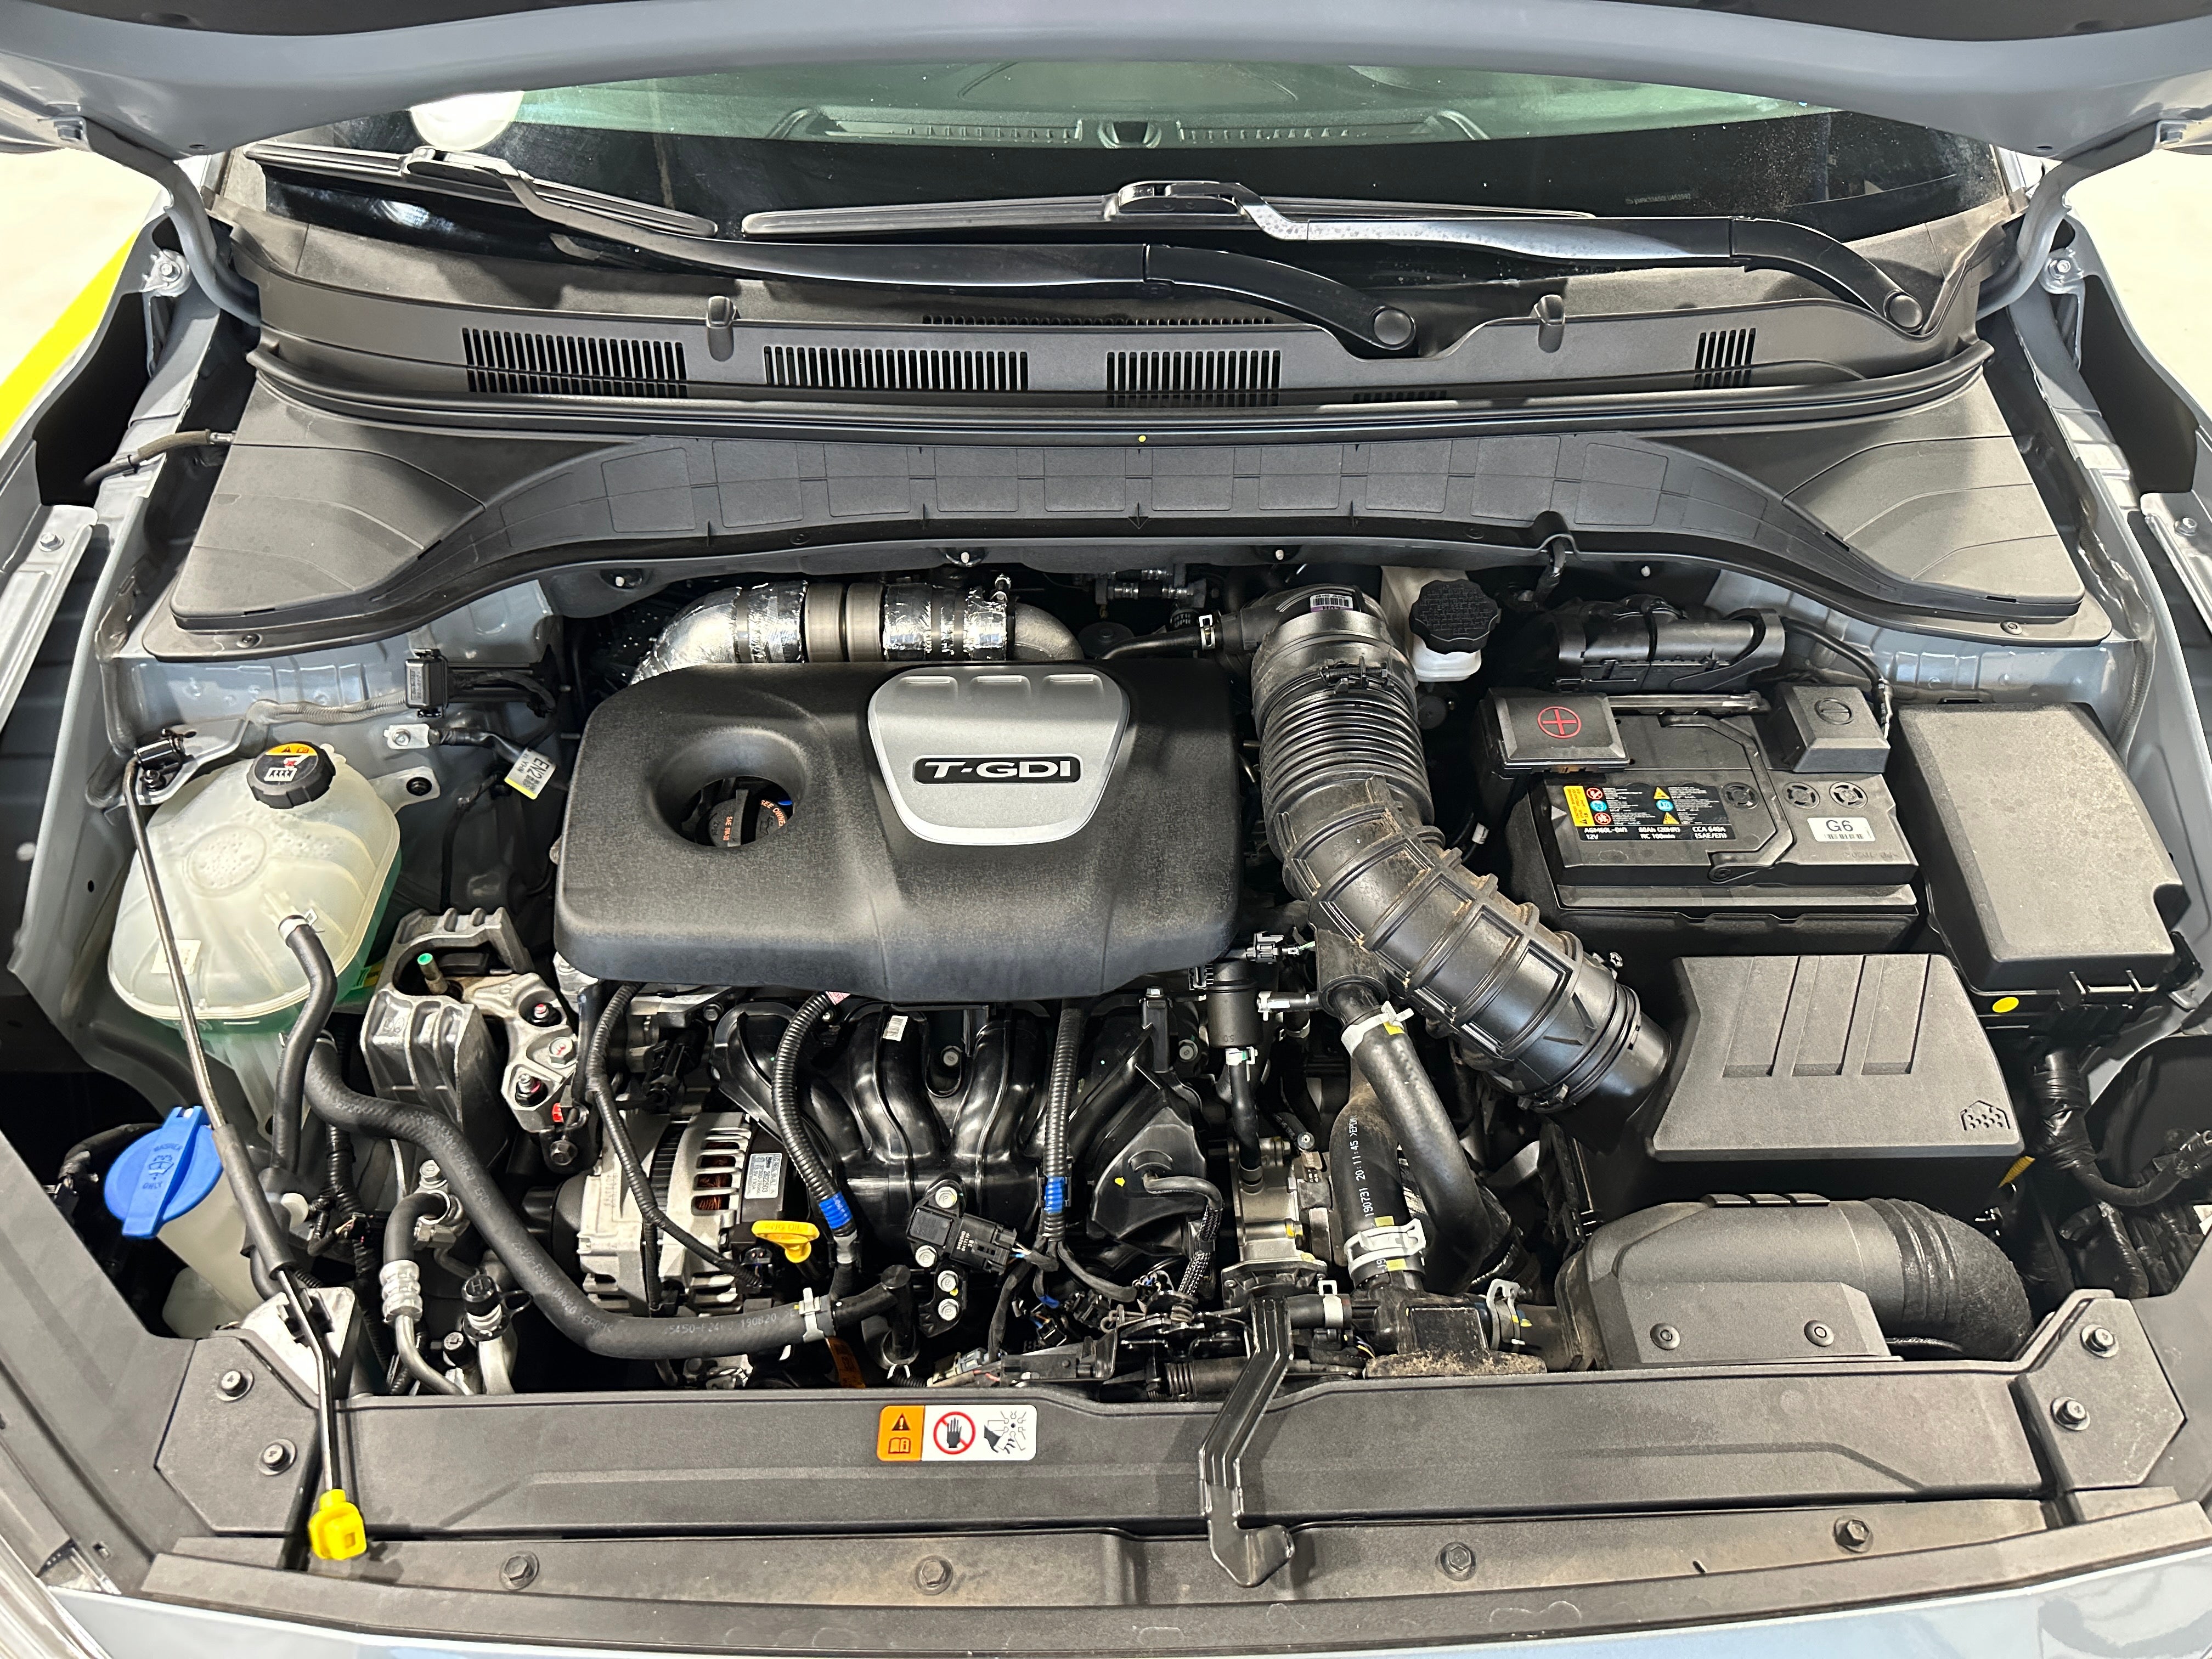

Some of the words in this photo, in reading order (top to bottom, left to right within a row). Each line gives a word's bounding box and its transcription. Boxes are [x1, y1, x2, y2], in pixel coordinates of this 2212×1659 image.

[529, 758, 550, 780] EN2
[925, 760, 1071, 778] T-GDI
[760, 799, 774, 809] SEE
[772, 808, 786, 828] OWNE
[1826, 820, 1853, 832] G6
[1223, 1035, 1234, 1043] 5.0
[1350, 1141, 1365, 1180] 20:11:45
[142, 1181, 163, 1189] ONLY
[1359, 1187, 1375, 1216] 190731
[471, 1279, 483, 1293] H
[551, 1286, 578, 1316] 190820
[741, 1313, 777, 1328] 190820
